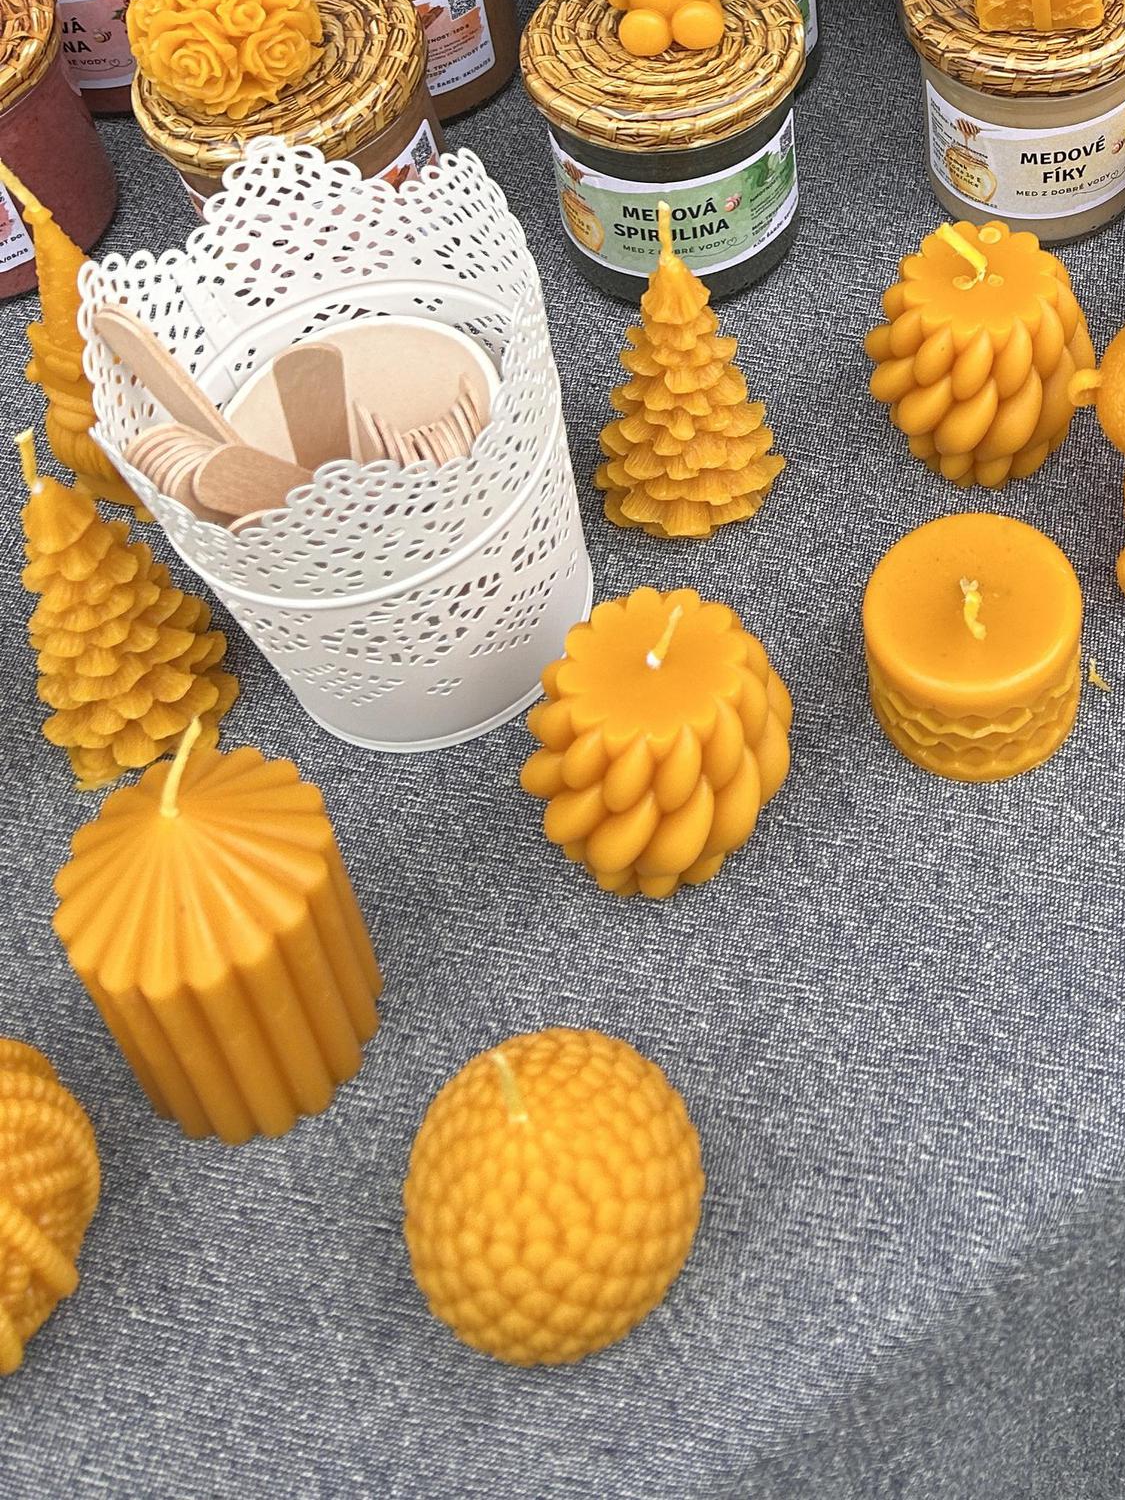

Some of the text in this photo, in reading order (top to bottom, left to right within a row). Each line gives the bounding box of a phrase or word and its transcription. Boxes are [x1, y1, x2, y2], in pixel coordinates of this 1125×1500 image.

[1020, 135, 1106, 165] MEDOVÉ
[1042, 189, 1048, 197] Z
[1051, 182, 1085, 196] DOBRÉ
[1087, 173, 1111, 188] VODY
[1043, 164, 1087, 184] FÍKY
[623, 198, 717, 222] MEOVÁ
[623, 239, 727, 255] MED Z VODY
